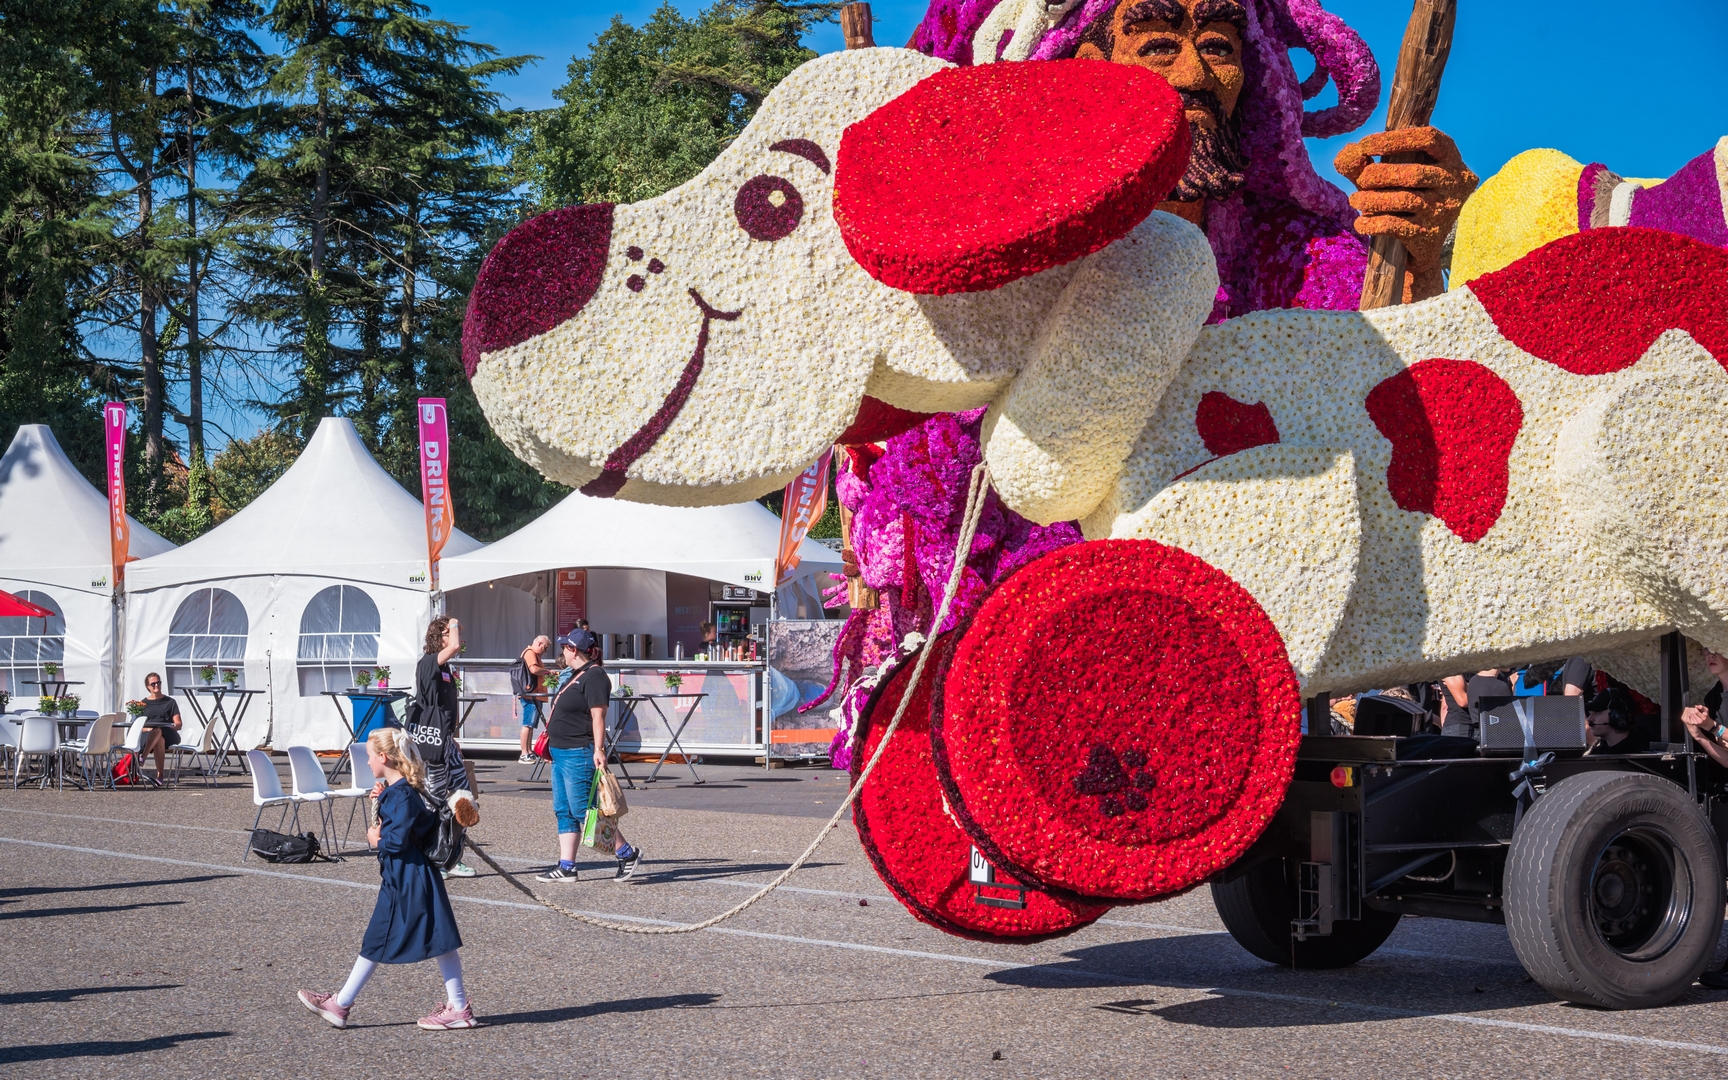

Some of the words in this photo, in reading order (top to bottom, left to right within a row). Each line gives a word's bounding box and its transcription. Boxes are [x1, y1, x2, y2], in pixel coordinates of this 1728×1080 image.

[424, 441, 444, 542] DRINKS
[791, 459, 819, 543] RINKS
[412, 734, 443, 746] ROOD
